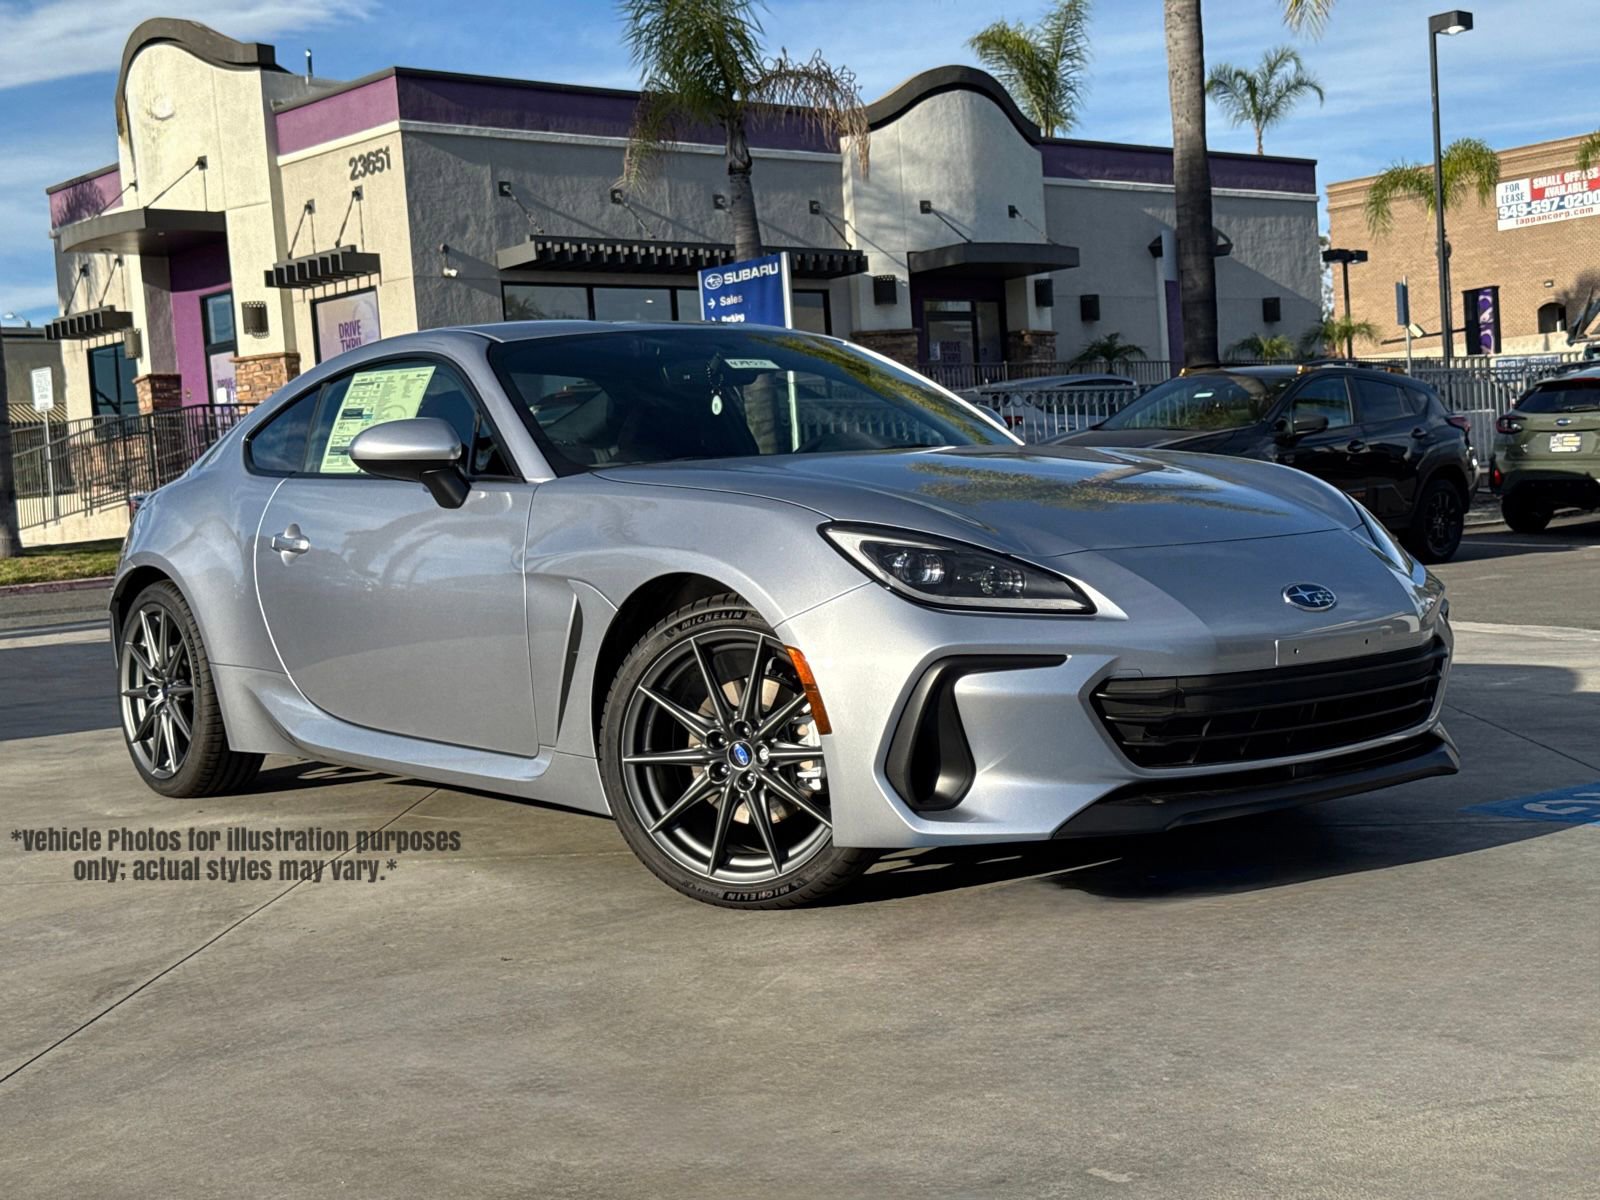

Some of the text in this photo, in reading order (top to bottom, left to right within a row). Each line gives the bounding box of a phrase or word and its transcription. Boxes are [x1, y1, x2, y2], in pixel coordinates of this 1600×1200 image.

[348, 145, 391, 181] 23651
[1505, 183, 1520, 193] FOR
[1532, 174, 1562, 189] SMALL
[1544, 181, 1588, 198] AVAILABLE
[1499, 189, 1600, 219] 949-597-0200
[1501, 191, 1525, 205] LEASE
[1516, 207, 1593, 225] tappancorp.com
[723, 262, 779, 285] SUBARU
[719, 294, 743, 306] Sales
[338, 320, 362, 339] DRIVE
[681, 611, 742, 630] MICHELIN
[726, 883, 791, 901] MICHELIN
